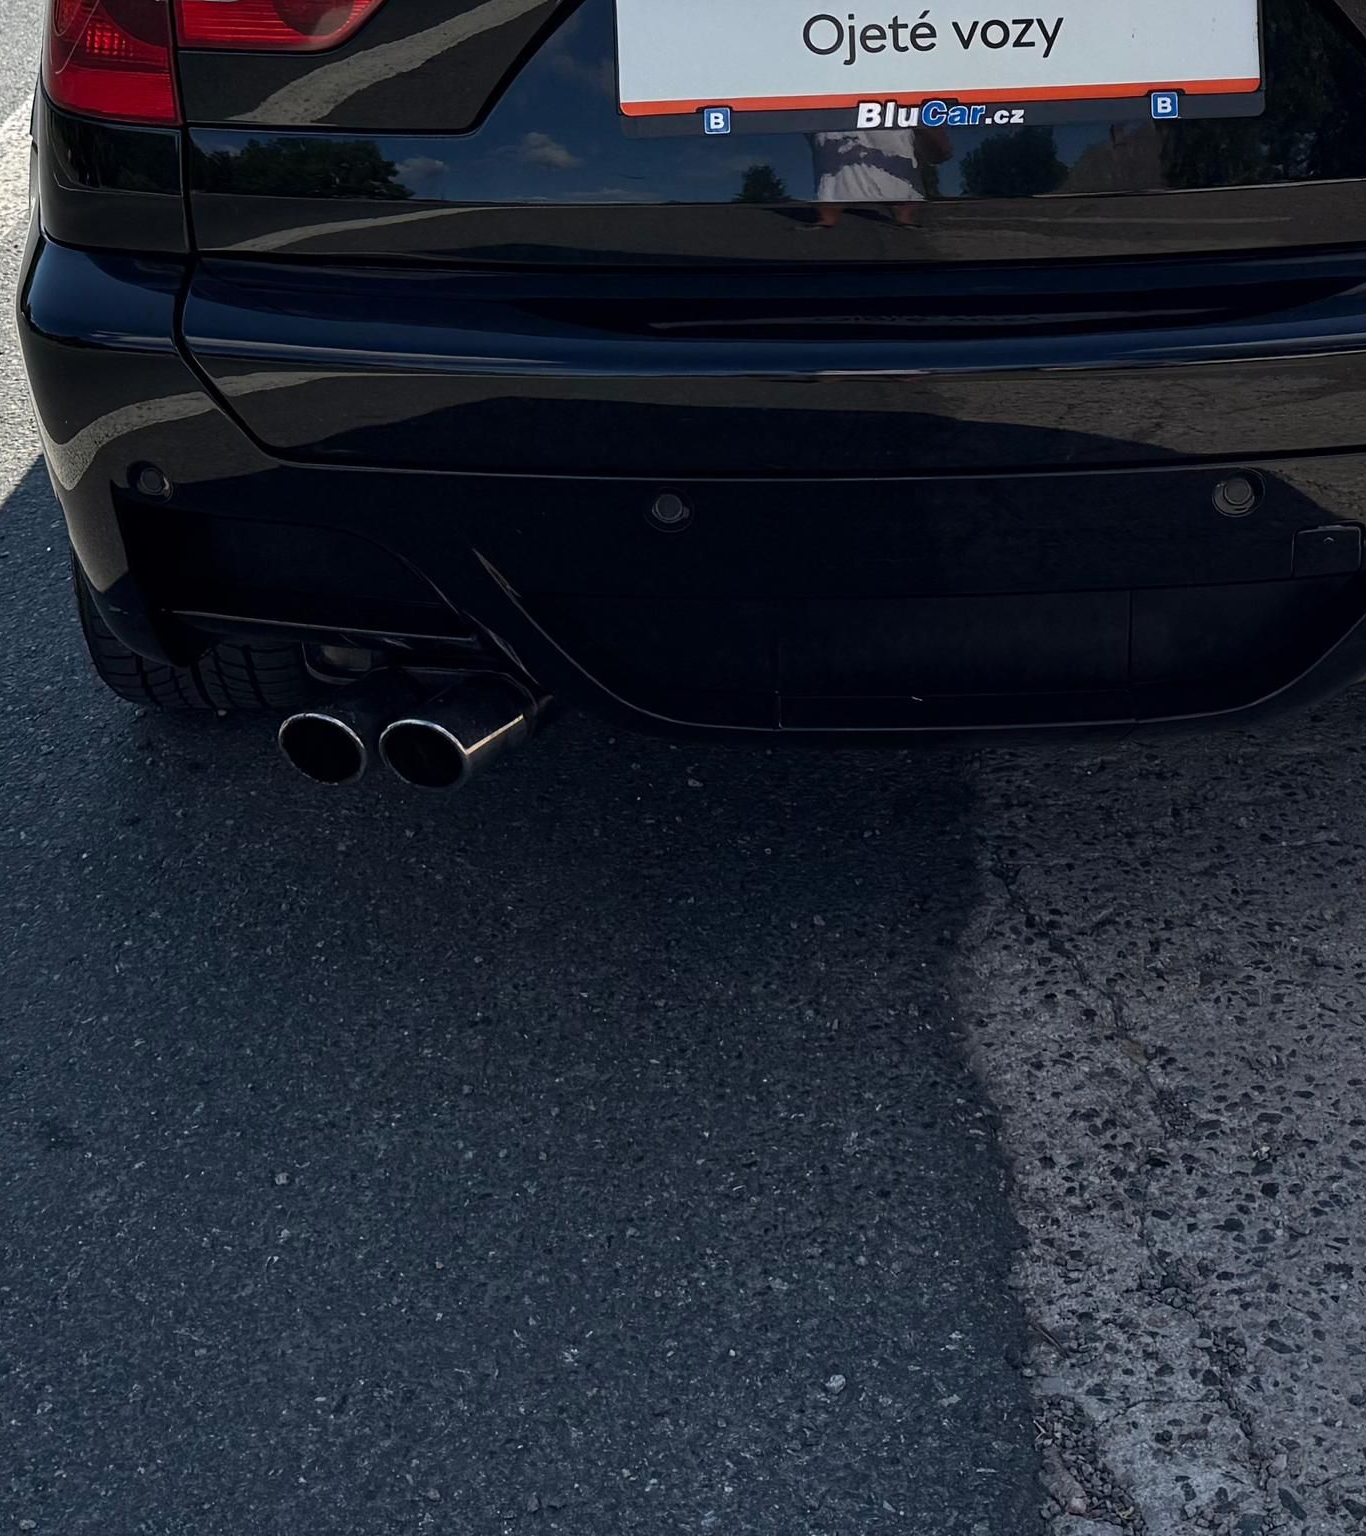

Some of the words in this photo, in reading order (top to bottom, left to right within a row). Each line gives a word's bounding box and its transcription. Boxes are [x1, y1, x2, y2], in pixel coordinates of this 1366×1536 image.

[802, 10, 937, 65] Ojeté
[951, 17, 1064, 58] vozy
[856, 100, 1025, 129] BluCar.cz
[1157, 97, 1172, 113] B
[710, 113, 725, 129] B
